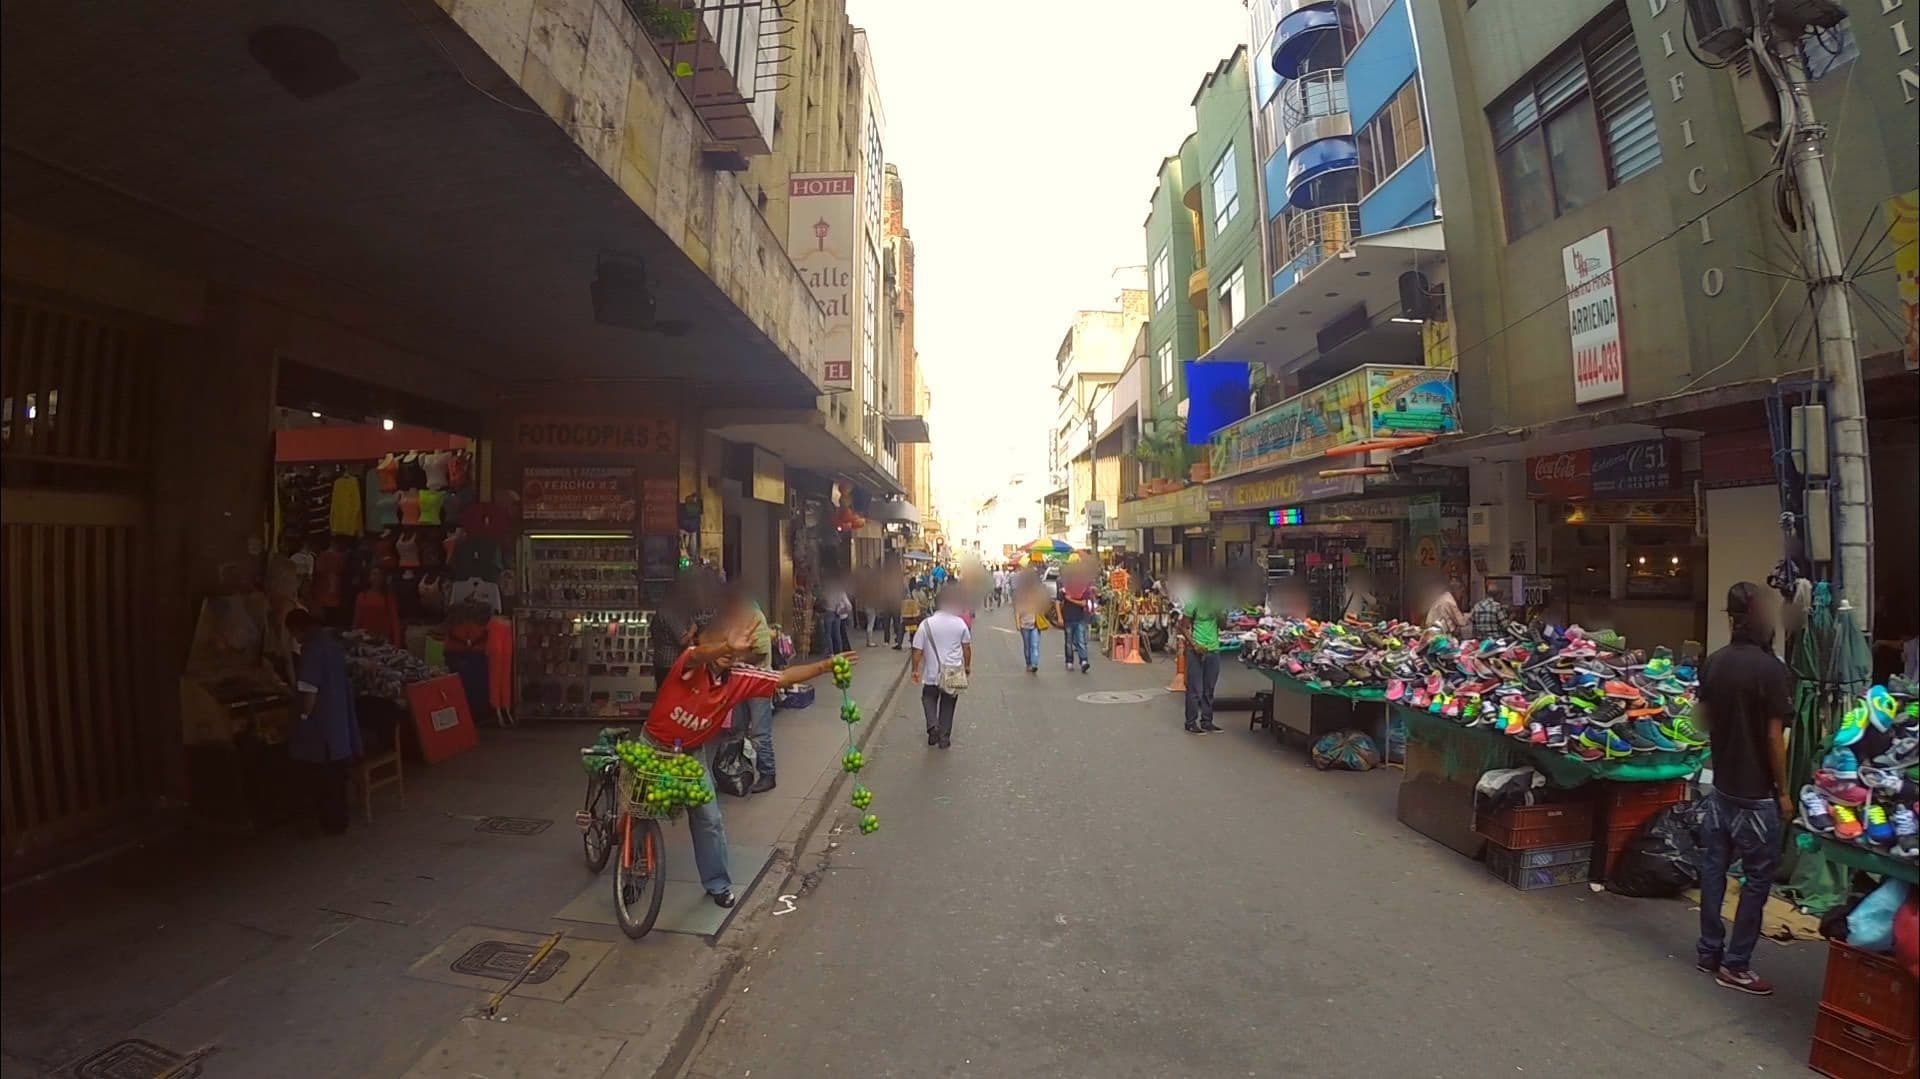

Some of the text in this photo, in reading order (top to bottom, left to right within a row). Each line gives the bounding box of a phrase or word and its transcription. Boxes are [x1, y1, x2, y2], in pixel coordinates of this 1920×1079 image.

[792, 179, 851, 195] HOTEL
[797, 266, 849, 288] alle
[817, 293, 849, 317] eal
[1571, 298, 1616, 337] ARRIENDA
[518, 421, 649, 447] FOTOCOPIAS
[1534, 455, 1577, 481] Coca-Cola
